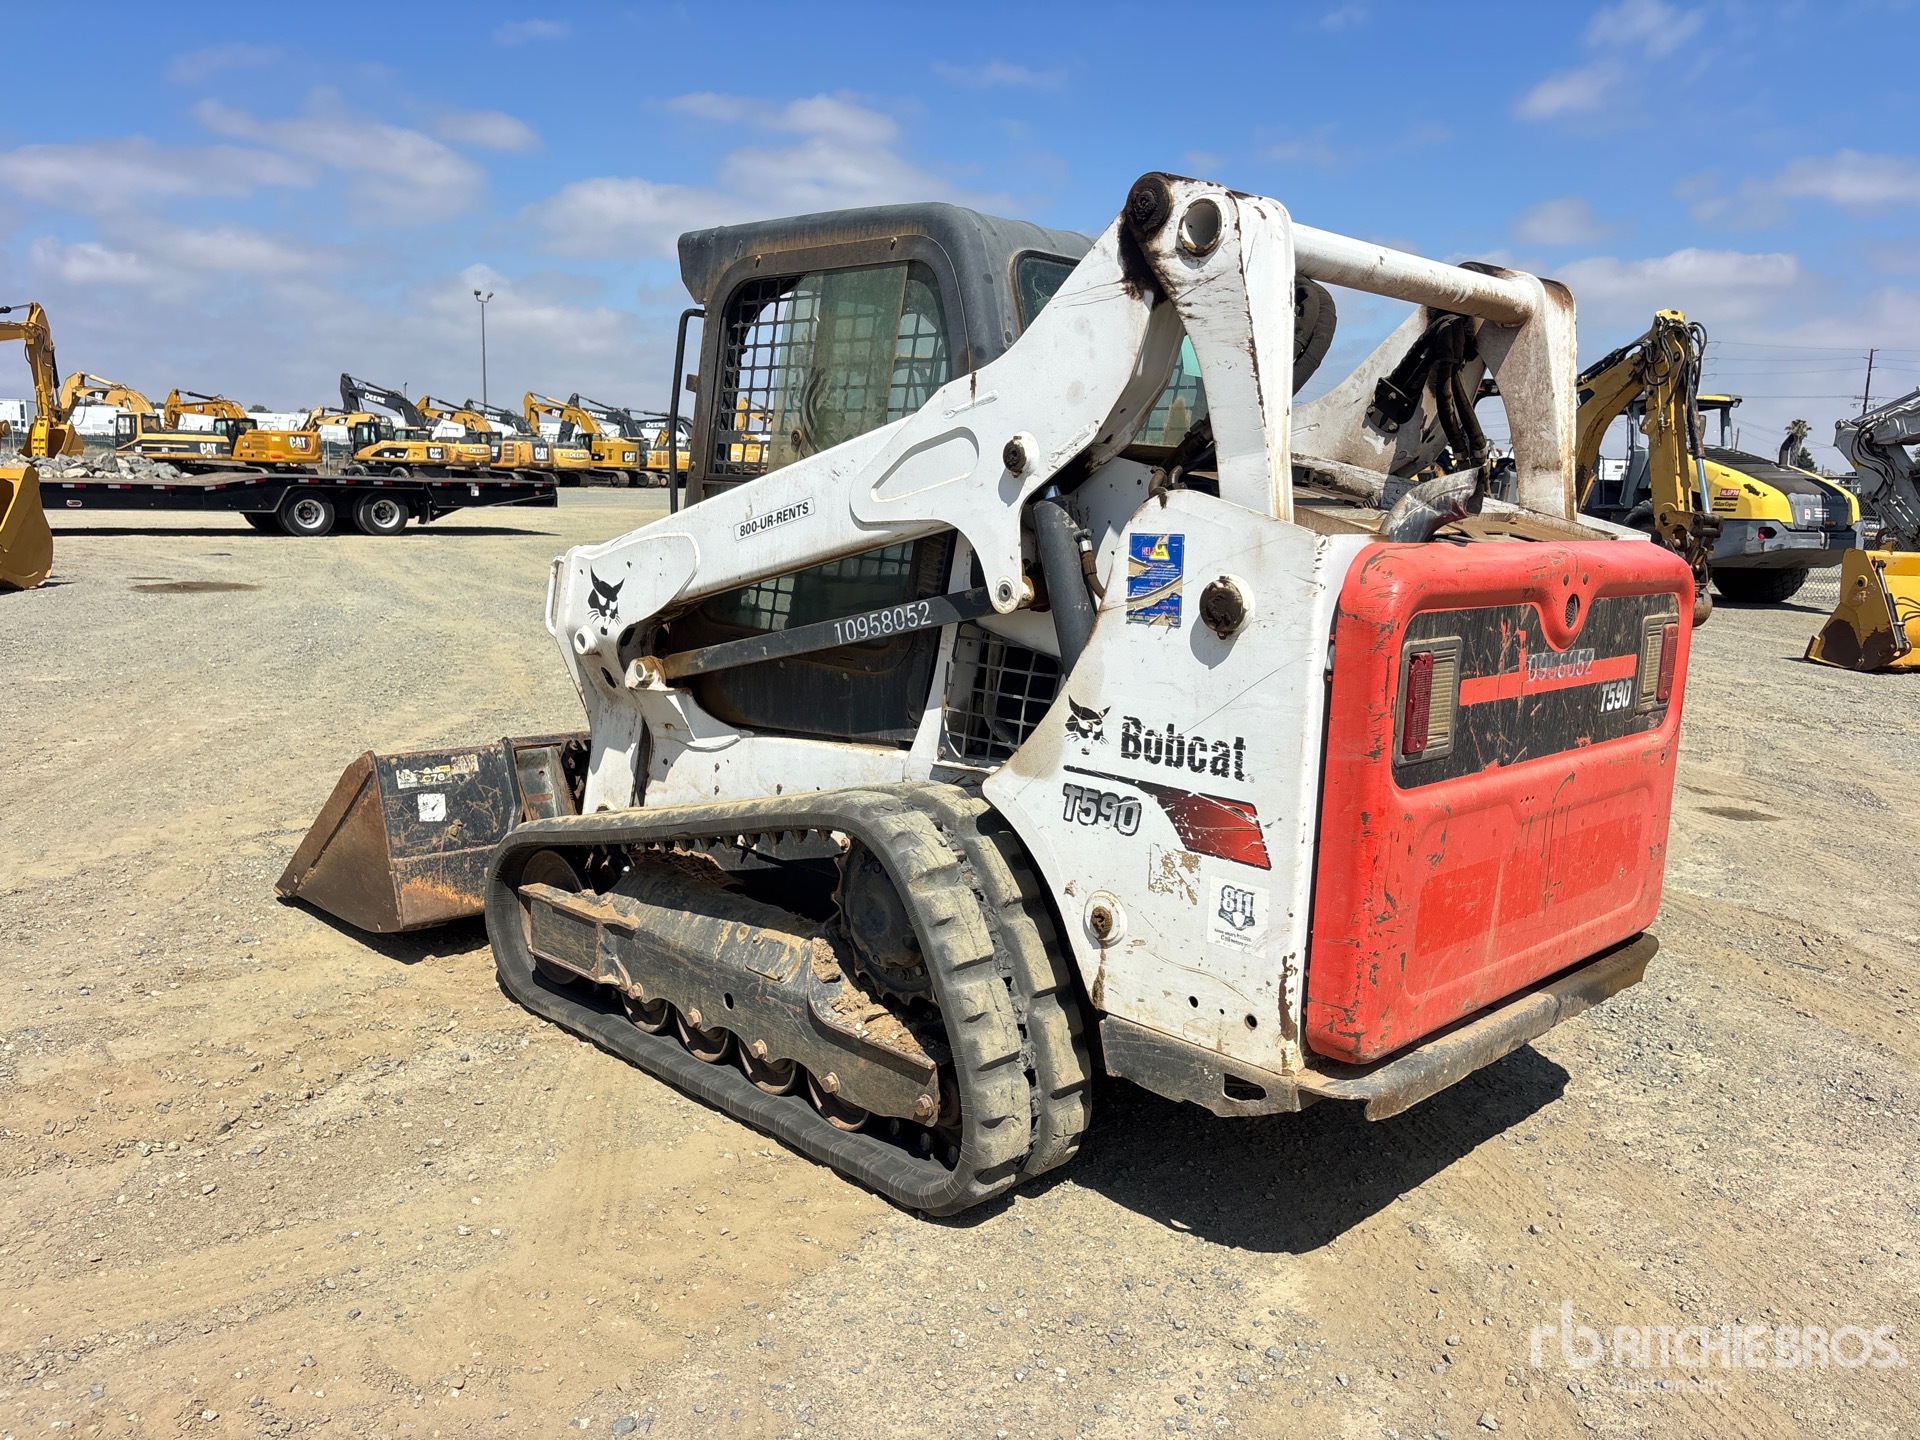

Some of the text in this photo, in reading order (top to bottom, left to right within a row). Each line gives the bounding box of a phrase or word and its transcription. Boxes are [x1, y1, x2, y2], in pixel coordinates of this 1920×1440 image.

[364, 391, 386, 404] DEERE
[442, 412, 452, 420] CAT
[484, 412, 501, 422] DEERE
[551, 408, 561, 417] CAT
[645, 421, 667, 429] DEERE
[200, 442, 217, 455] CAT
[289, 436, 306, 449] CAT
[535, 447, 548, 460] CAT
[624, 452, 636, 462] CAT
[740, 501, 809, 537] 800-UR-RENTS
[834, 601, 932, 644] 10958052
[1601, 680, 1632, 712] T590
[1120, 715, 1247, 782] Bobcat
[1063, 782, 1142, 837] T590
[1221, 885, 1255, 917] 811
